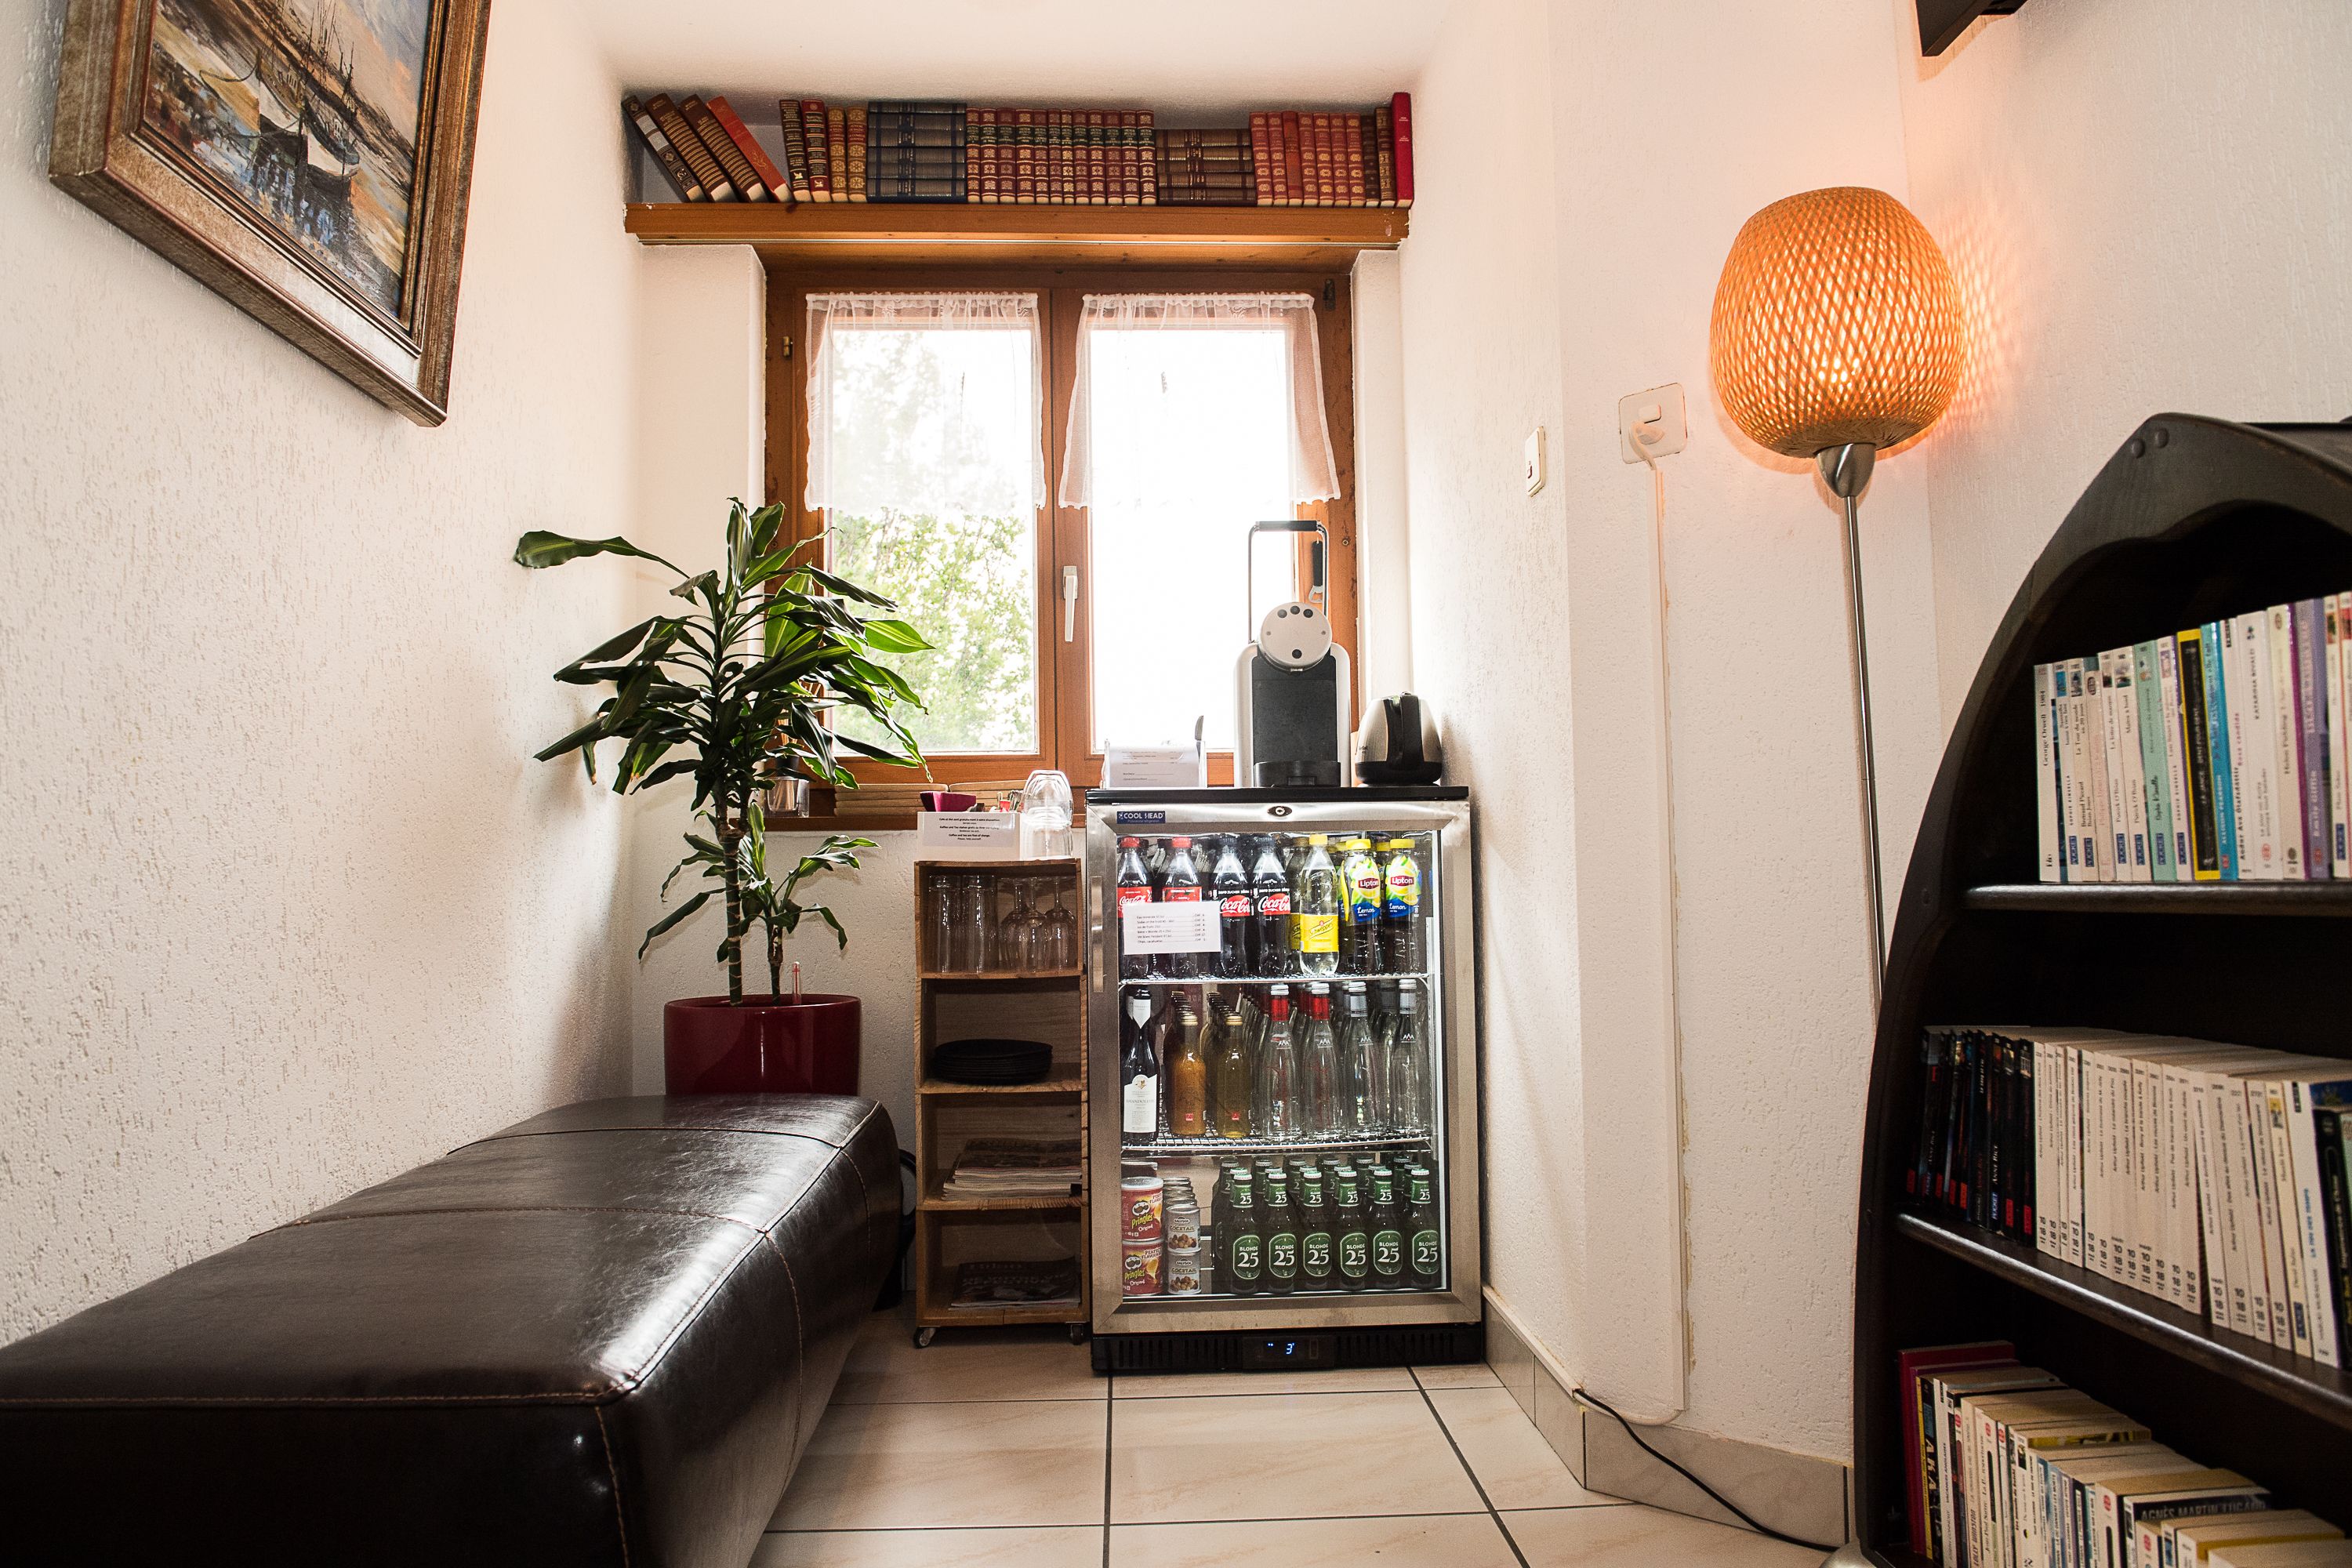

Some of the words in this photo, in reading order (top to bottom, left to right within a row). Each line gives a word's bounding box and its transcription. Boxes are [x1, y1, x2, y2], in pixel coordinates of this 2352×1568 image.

[1359, 880, 1379, 888] Lipton
[1392, 877, 1413, 885] Lipton
[1240, 1196, 1252, 1204] 25
[1275, 1194, 1287, 1203] 25
[1309, 1194, 1322, 1203] 25
[1347, 1194, 1359, 1203] 25
[1379, 1192, 1392, 1201] 25
[1420, 1192, 1430, 1200] 25
[1131, 1214, 1153, 1229] Pringles
[1237, 1251, 1259, 1268] 25
[1273, 1250, 1294, 1266] 25
[1307, 1249, 1330, 1265] 25
[1345, 1250, 1367, 1265] 25
[1377, 1247, 1399, 1263] 25
[1417, 1247, 1438, 1262] 25
[1124, 1269, 1145, 1281] Pringles
